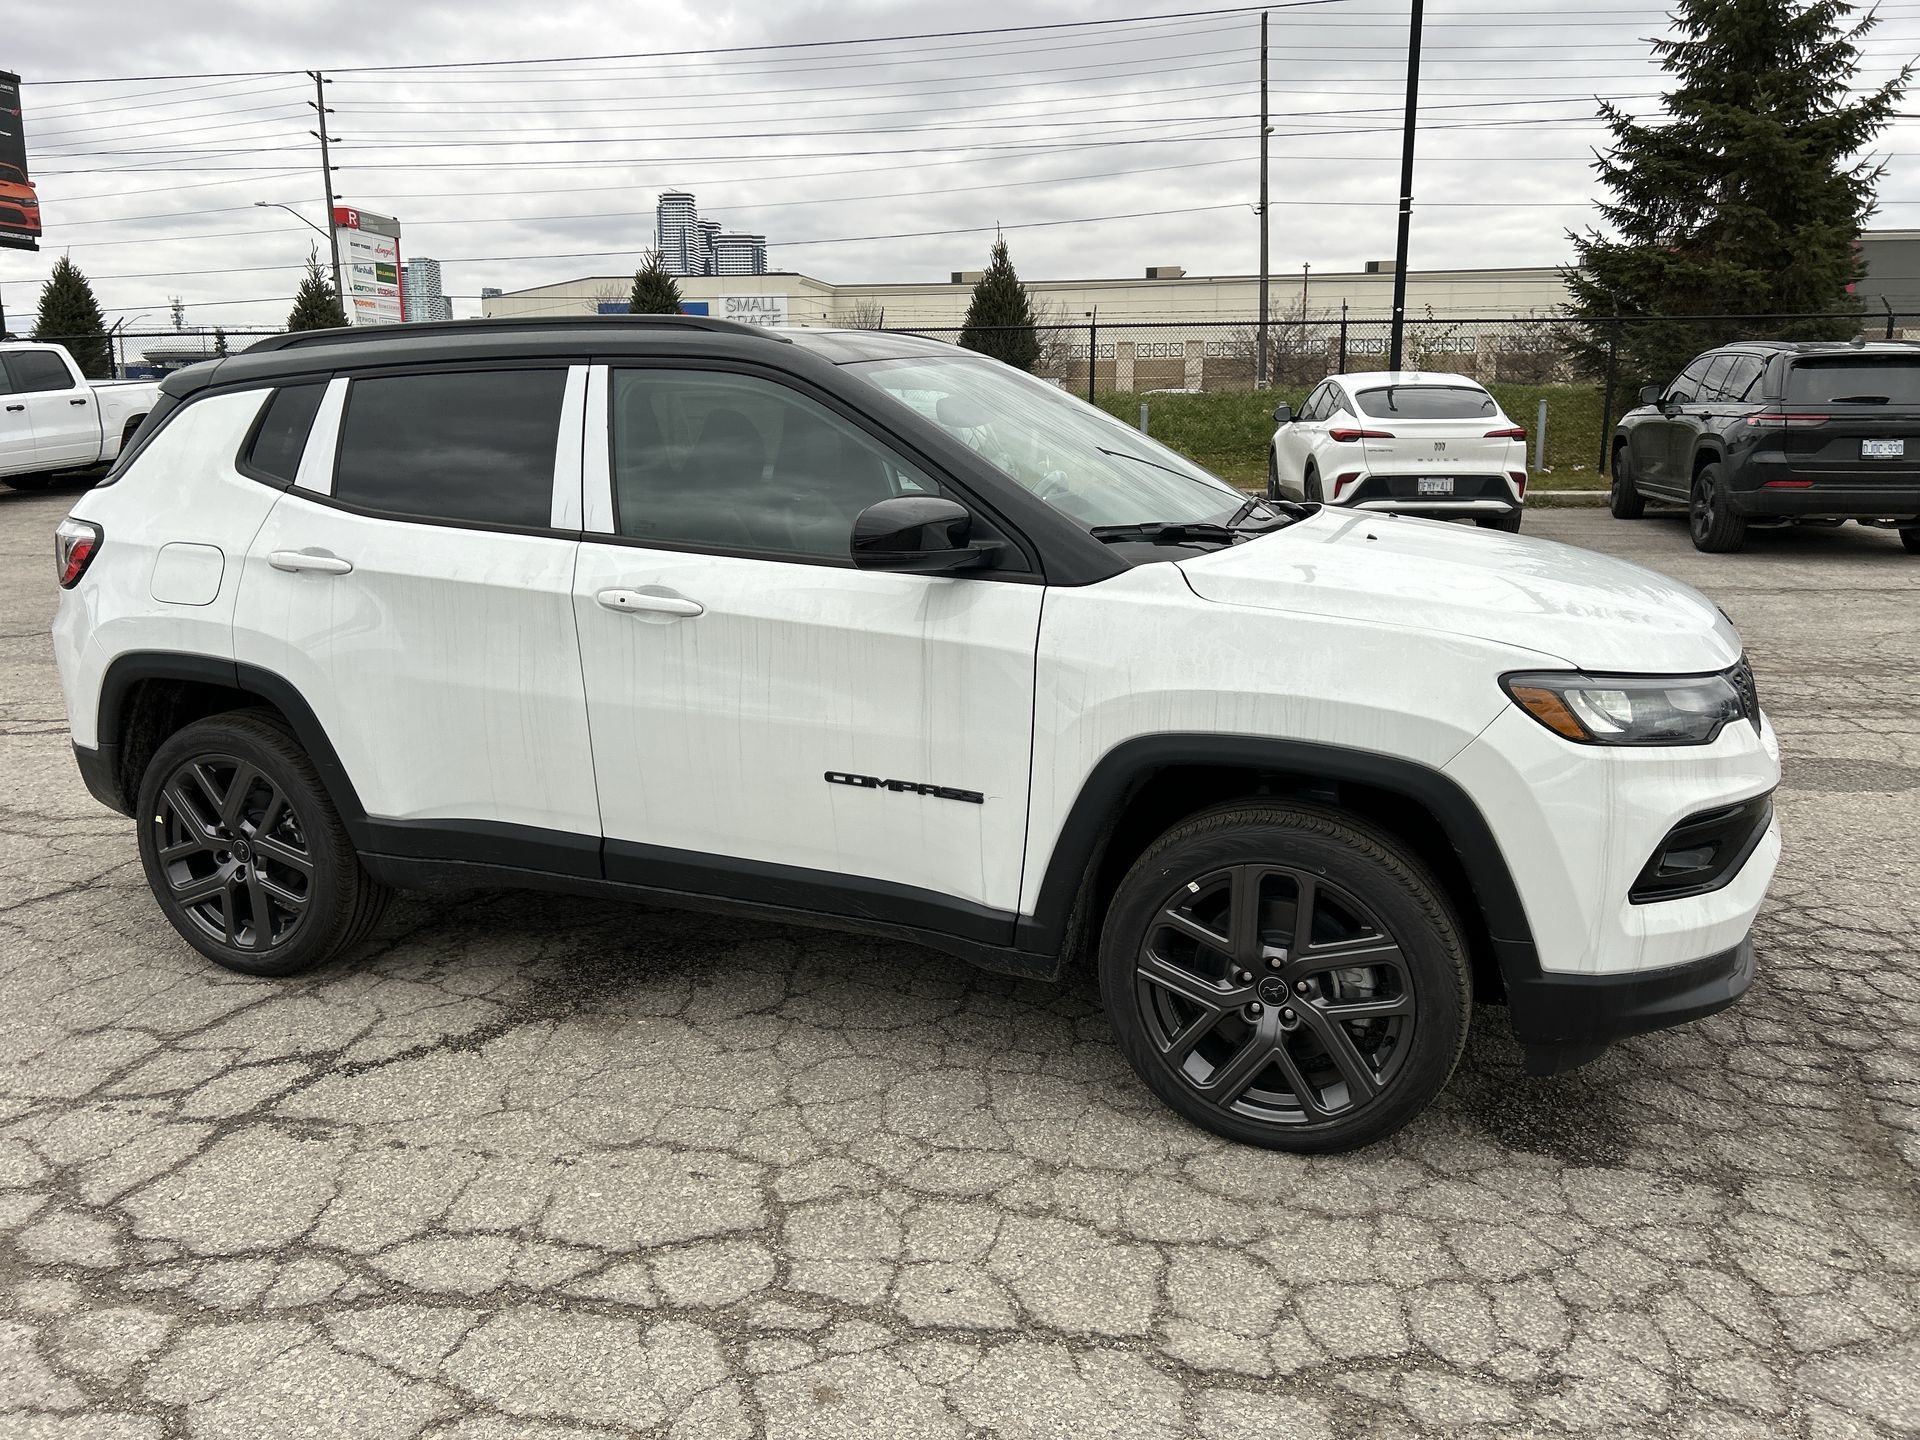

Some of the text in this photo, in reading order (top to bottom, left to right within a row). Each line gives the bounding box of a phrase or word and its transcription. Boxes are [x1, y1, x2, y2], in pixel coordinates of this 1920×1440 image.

[348, 211, 357, 225] R
[353, 264, 375, 275] Marshalls
[725, 297, 781, 312] SMALL
[824, 771, 984, 804] COMPASS
